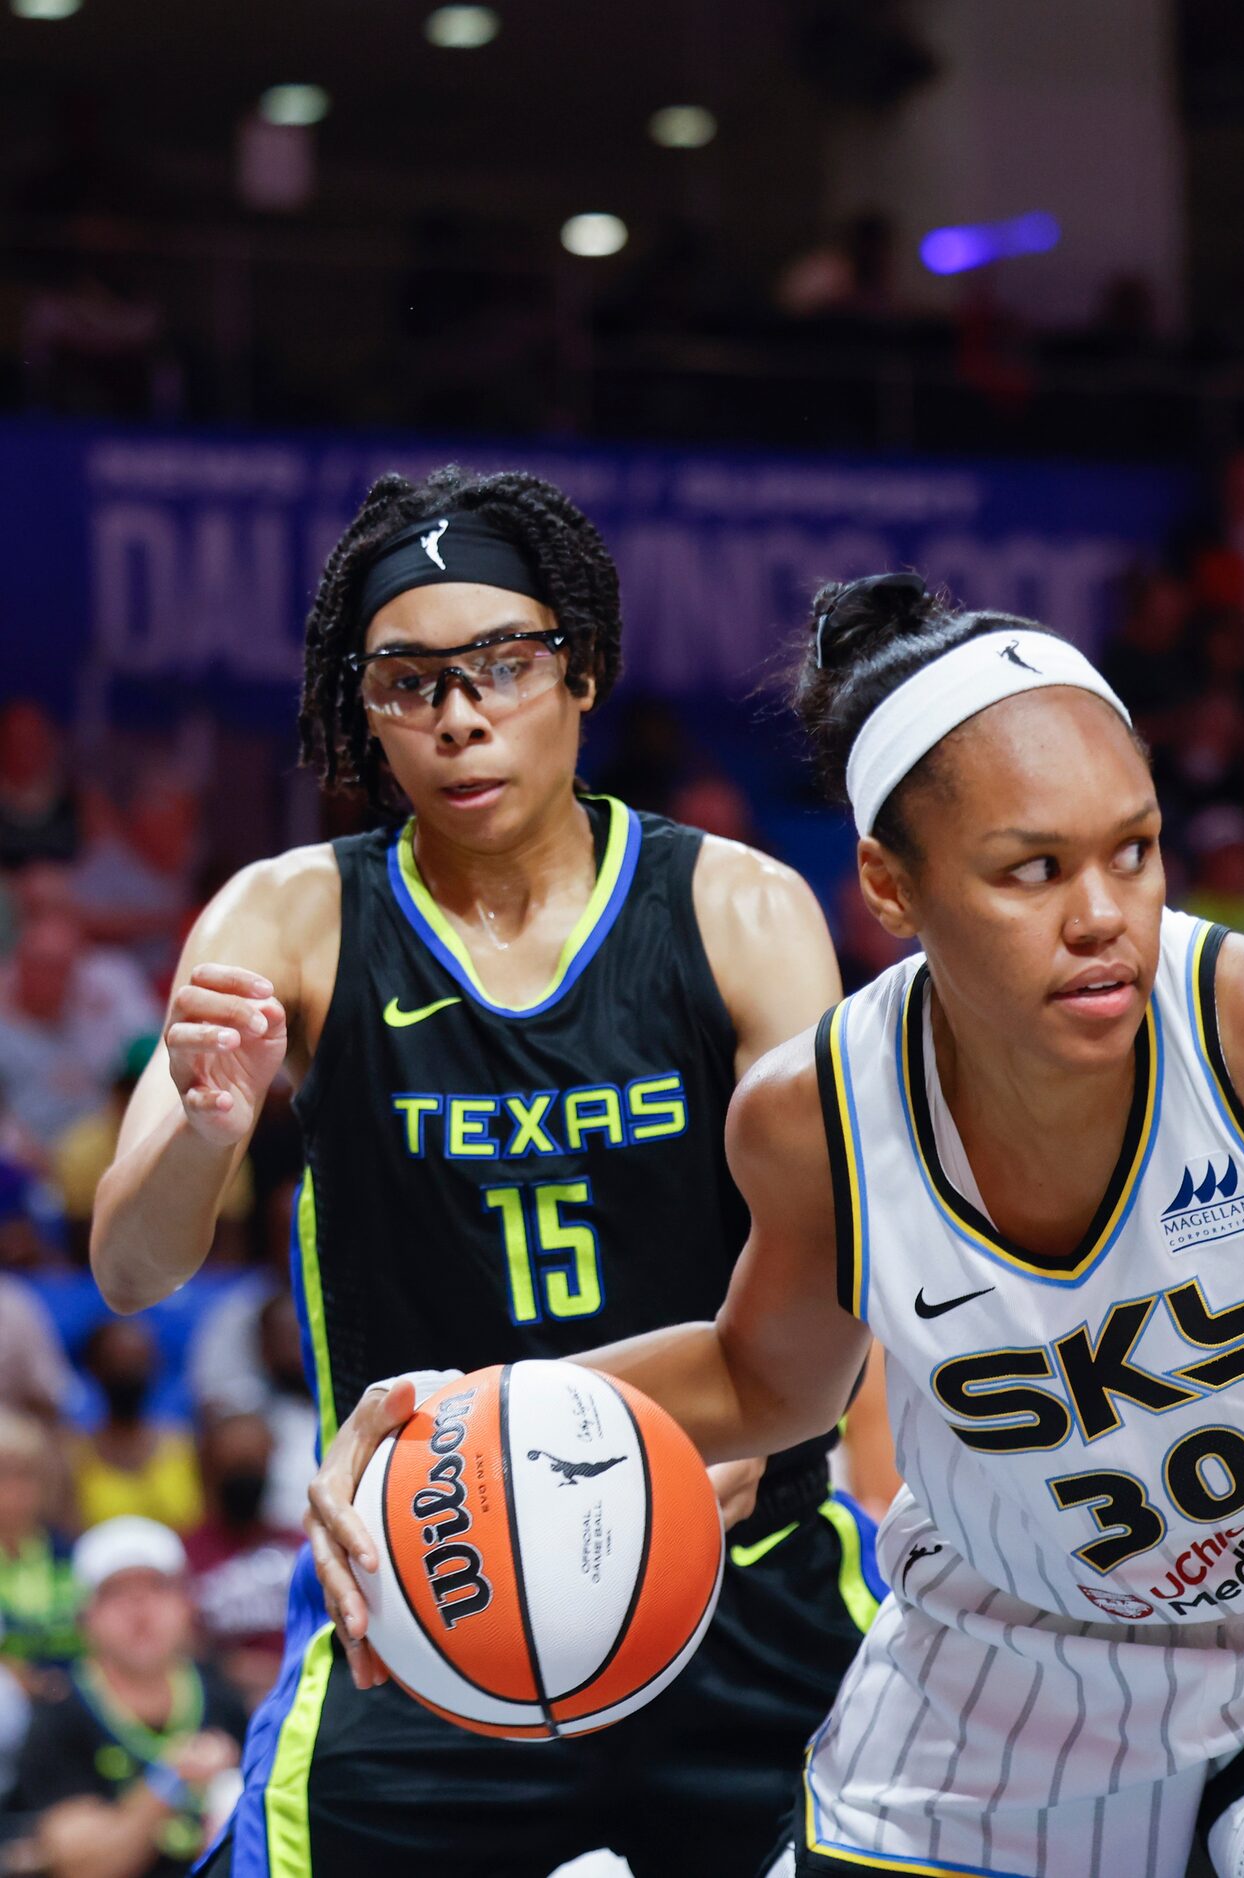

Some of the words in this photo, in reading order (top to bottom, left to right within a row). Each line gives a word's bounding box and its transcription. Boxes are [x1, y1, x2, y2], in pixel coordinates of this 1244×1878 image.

[391, 1070, 688, 1160] TEXAS
[479, 1174, 606, 1327] 15
[411, 1386, 494, 1632] Wilson
